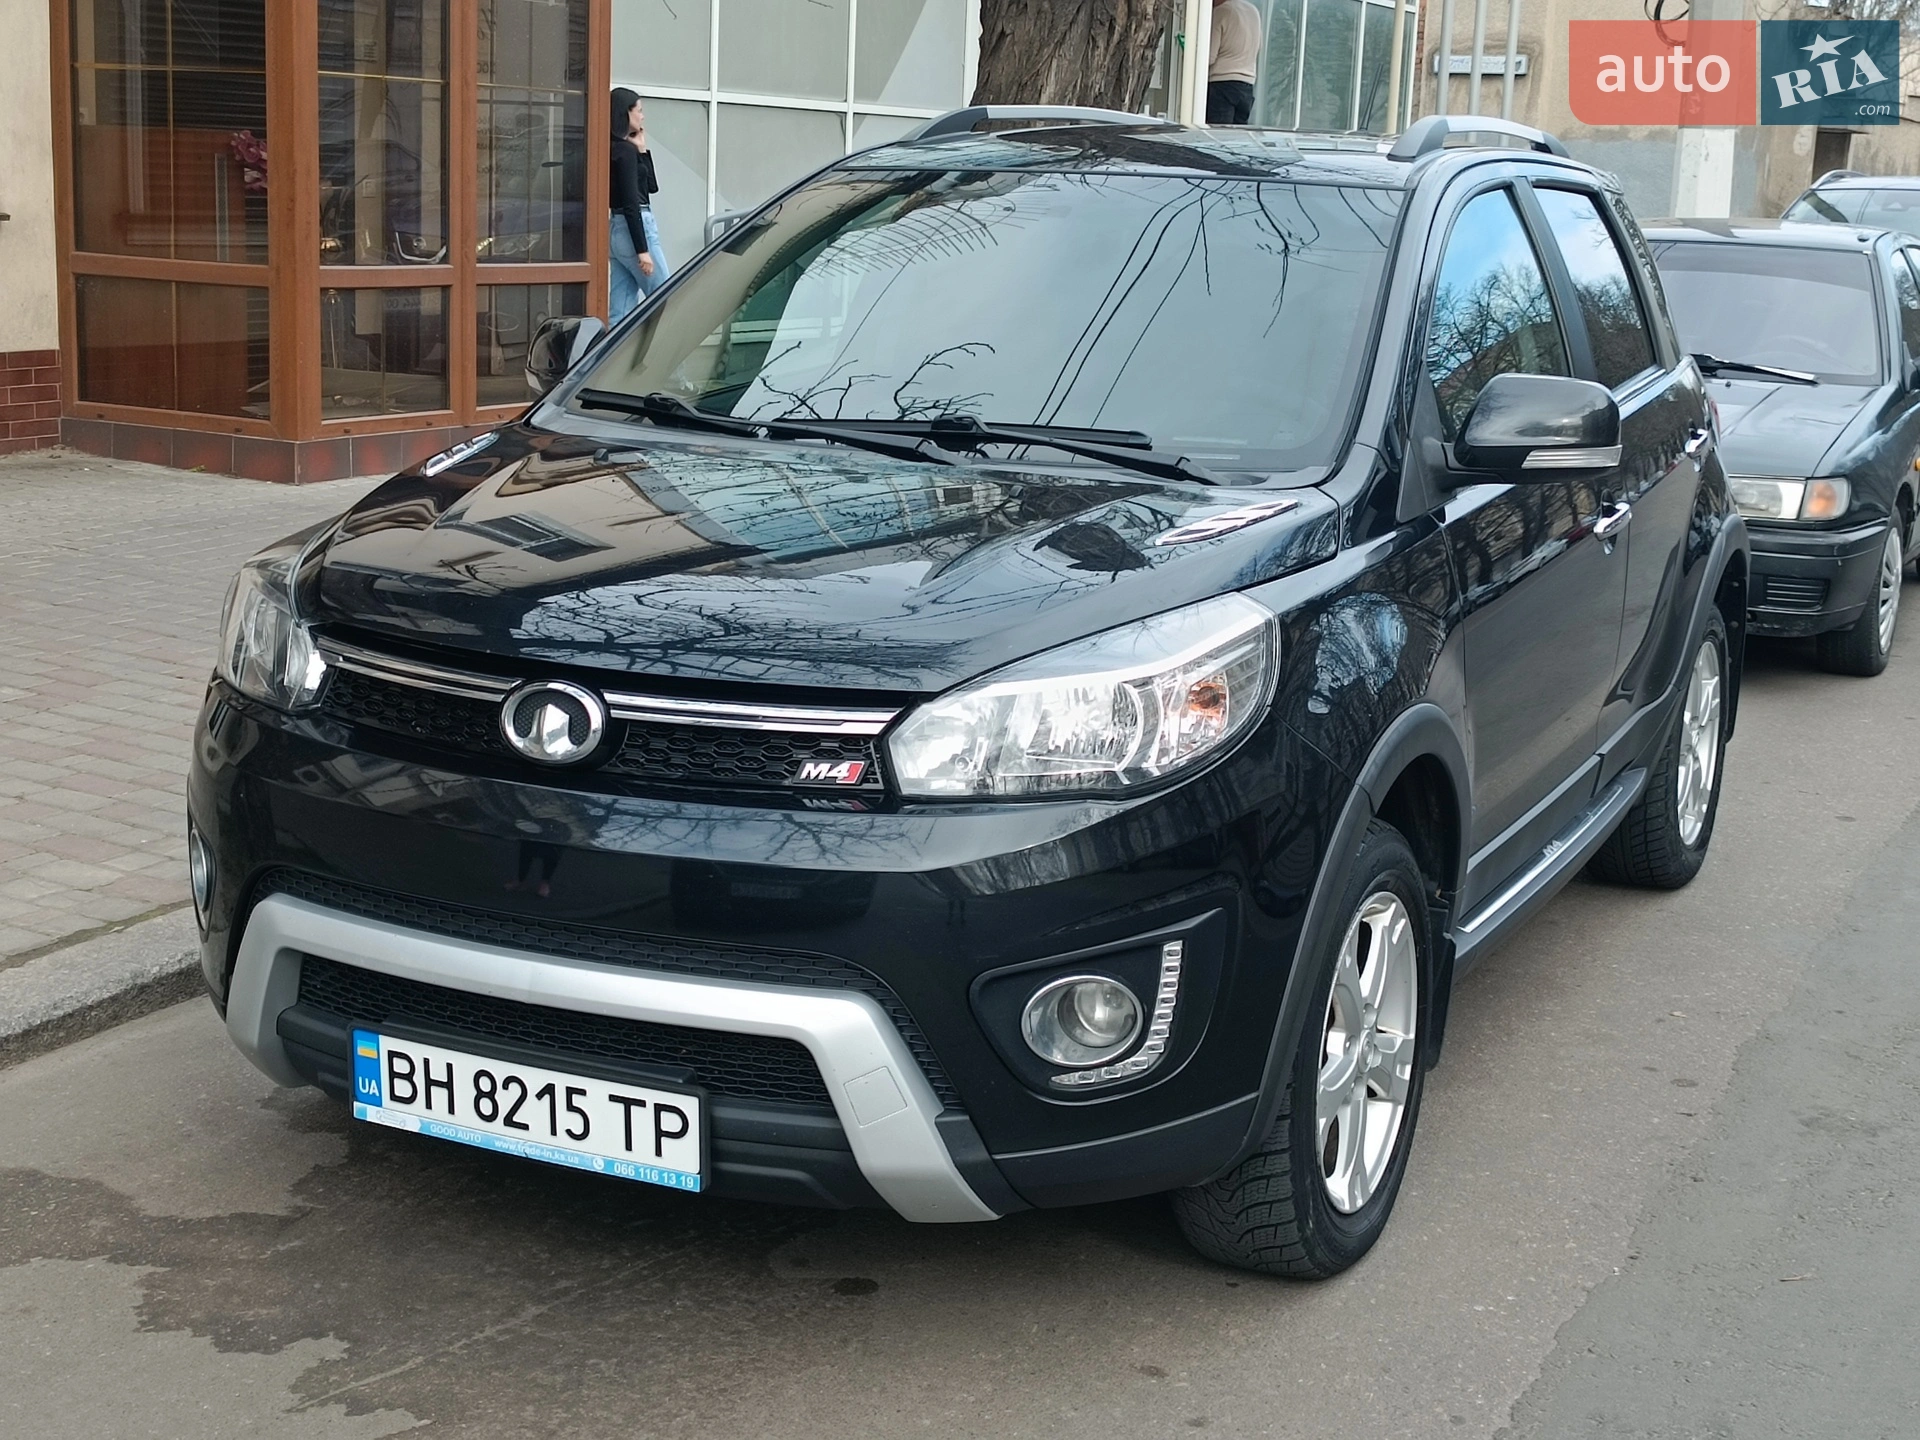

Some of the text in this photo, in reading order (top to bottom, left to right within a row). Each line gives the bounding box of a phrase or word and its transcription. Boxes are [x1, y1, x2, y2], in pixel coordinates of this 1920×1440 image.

[800, 761, 865, 784] M4
[358, 1076, 379, 1098] UA
[387, 1049, 690, 1158] BH 8215 TP
[430, 1123, 456, 1137] GOOD
[457, 1129, 482, 1143] AUTO
[613, 1162, 636, 1177] 066
[639, 1167, 659, 1182] 116
[663, 1173, 677, 1186] 13
[679, 1177, 694, 1189] 19
